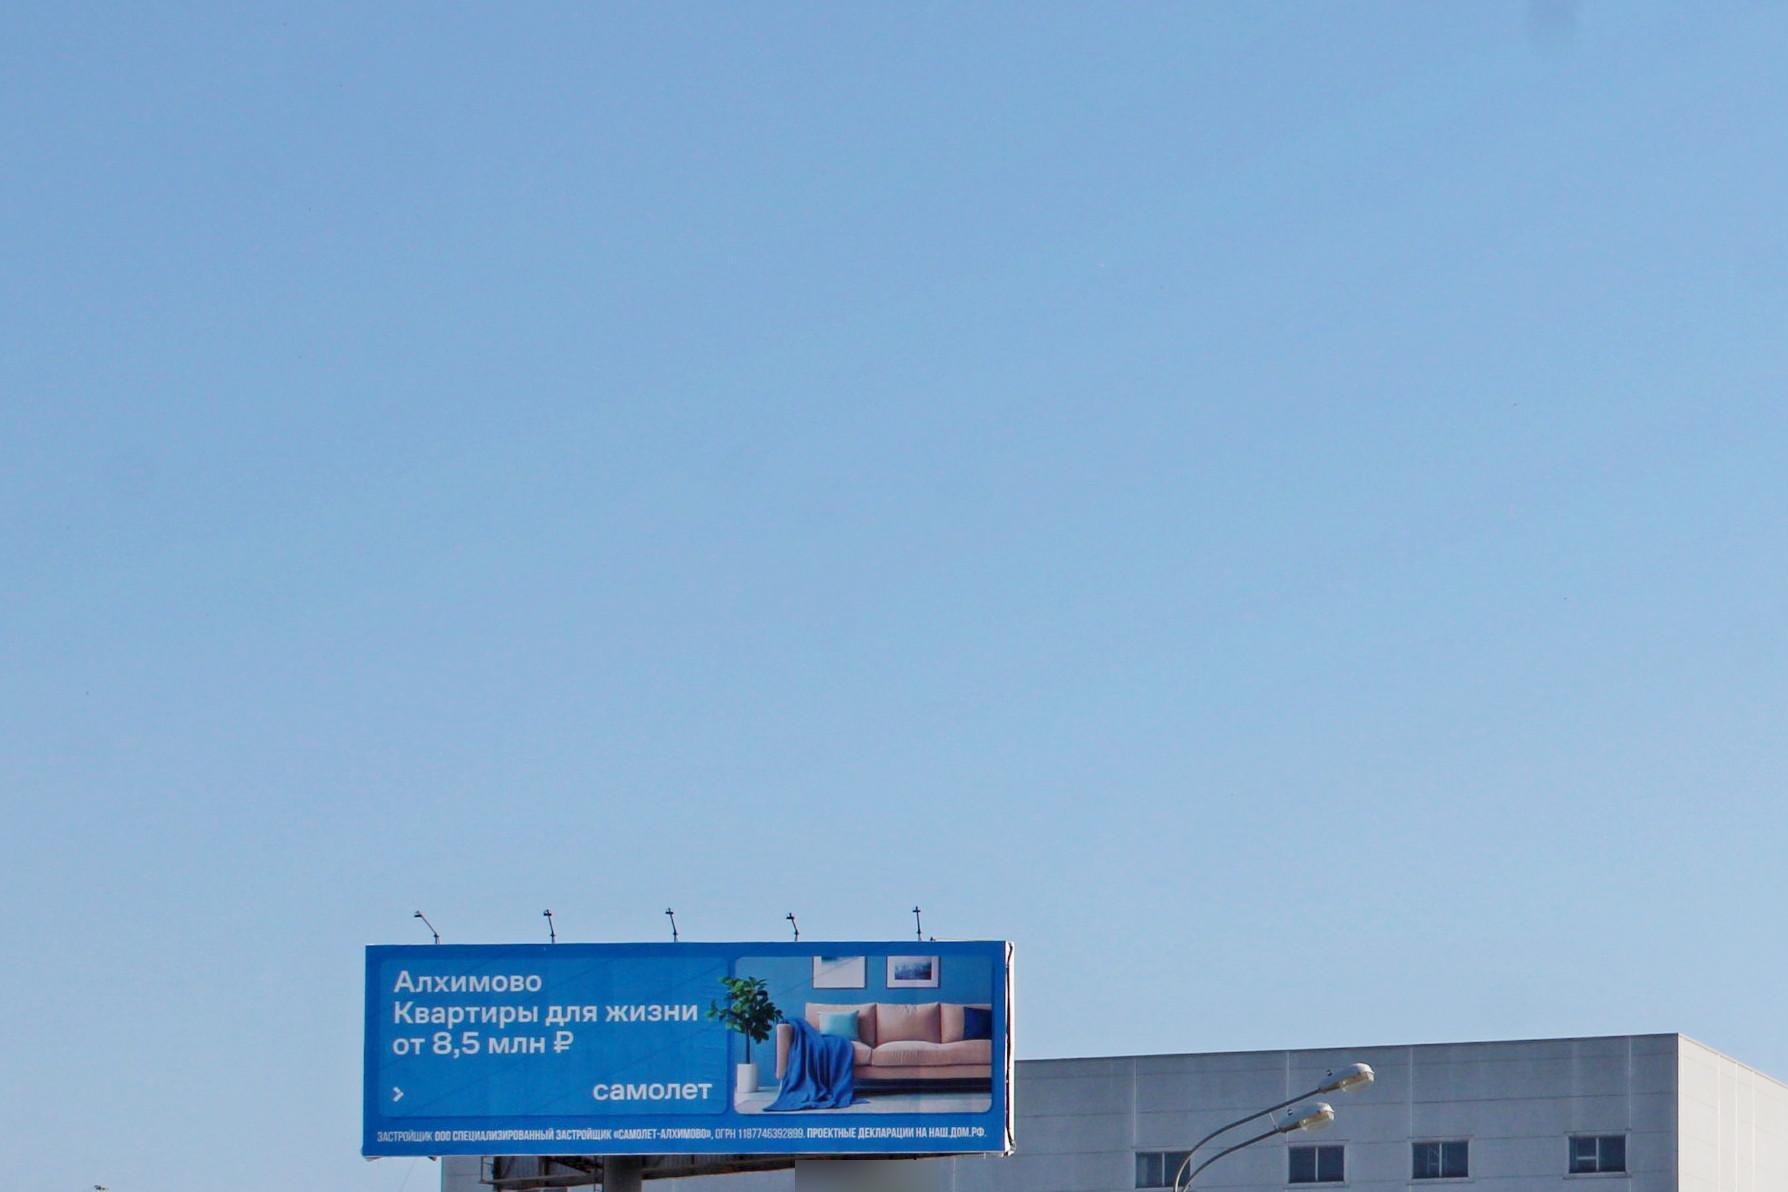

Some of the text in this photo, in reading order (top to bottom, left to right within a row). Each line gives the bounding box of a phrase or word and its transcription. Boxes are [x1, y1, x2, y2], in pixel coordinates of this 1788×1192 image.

[393, 970, 542, 993] Алхимово
[394, 1002, 698, 1028] Квартиры для жизни
[393, 1038, 425, 1055] от
[433, 1031, 480, 1058] 8,5
[488, 1036, 545, 1054] млн
[593, 1082, 713, 1101] самолет
[377, 1130, 432, 1142] ЗАСТРОЙЩИК
[435, 1130, 451, 1141] ООО
[453, 1128, 554, 1141] СПЕЦИАЛИЗИРОВАННЫЙ
[556, 1128, 611, 1141] ЗАСТРОЙЩИК
[715, 1129, 736, 1139] ОГРН
[807, 1127, 856, 1139] ПРОЕКТНЫЕ
[857, 1127, 914, 1140] ДЕКЛАРАЦИИ
[916, 1127, 927, 1138] НА
